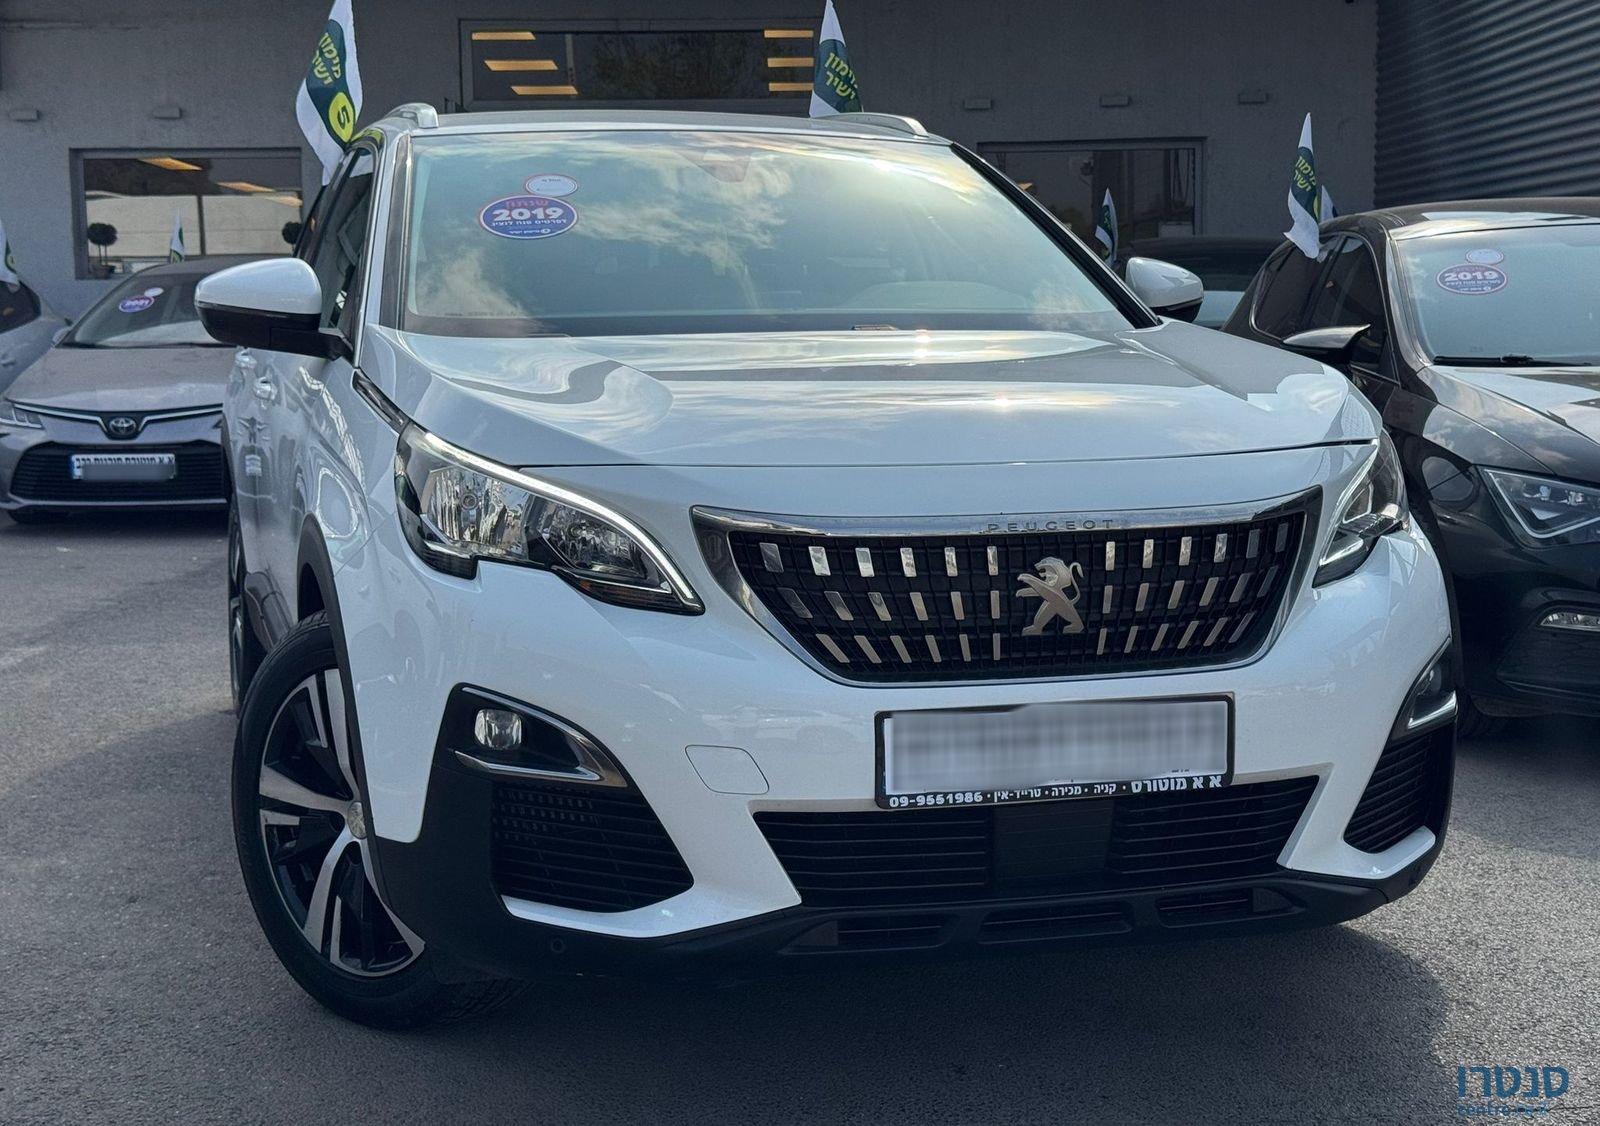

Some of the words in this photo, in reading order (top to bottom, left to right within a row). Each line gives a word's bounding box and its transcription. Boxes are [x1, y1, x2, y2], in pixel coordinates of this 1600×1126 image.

[826, 71, 856, 99] ישיר
[492, 207, 564, 222] 2019
[1443, 270, 1499, 282] 2019
[987, 519, 1113, 533] PEUGEOT
[1131, 777, 1188, 793] מוטורס
[1192, 776, 1204, 789] א
[1209, 775, 1222, 788] א
[993, 788, 1042, 803] טרייד-אין
[1051, 785, 1082, 797] מכירה
[1093, 783, 1117, 795] קניה
